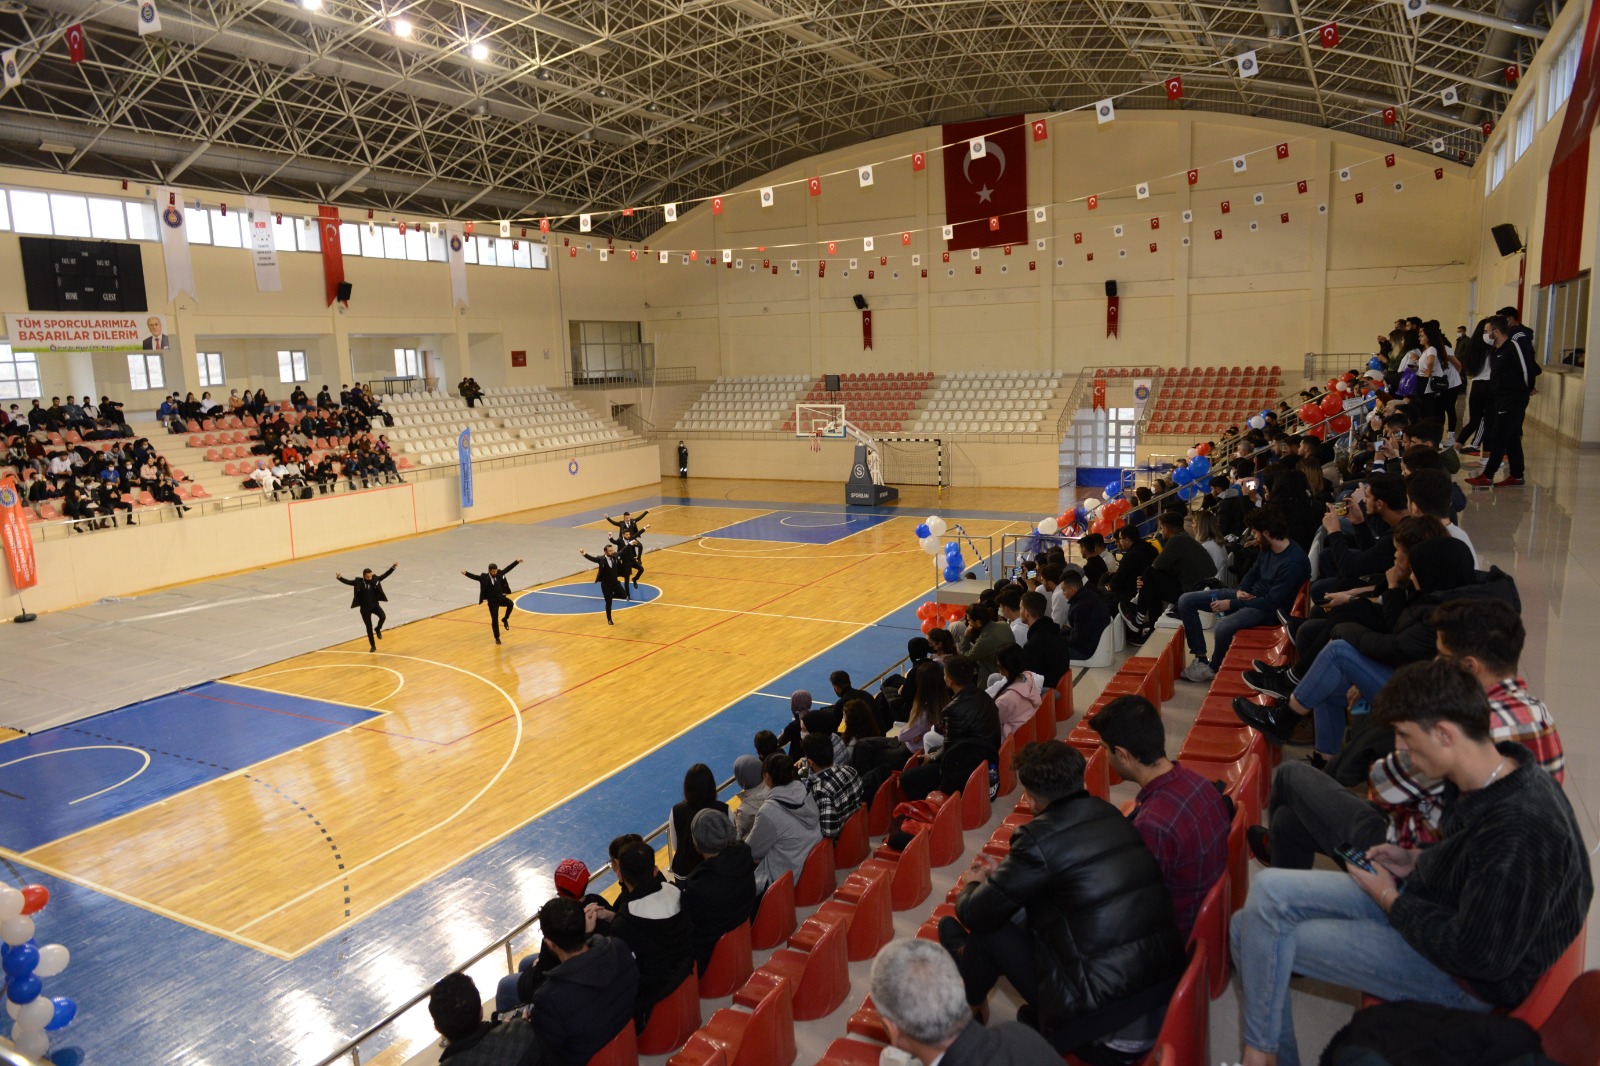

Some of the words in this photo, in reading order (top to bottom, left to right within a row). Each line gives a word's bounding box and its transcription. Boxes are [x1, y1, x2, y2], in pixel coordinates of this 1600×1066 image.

[102, 293, 116, 301] GUEST
[16, 317, 41, 329] TÜM
[44, 319, 137, 329] SPORCULARIMIZA
[18, 330, 90, 342] BAŞARILAR
